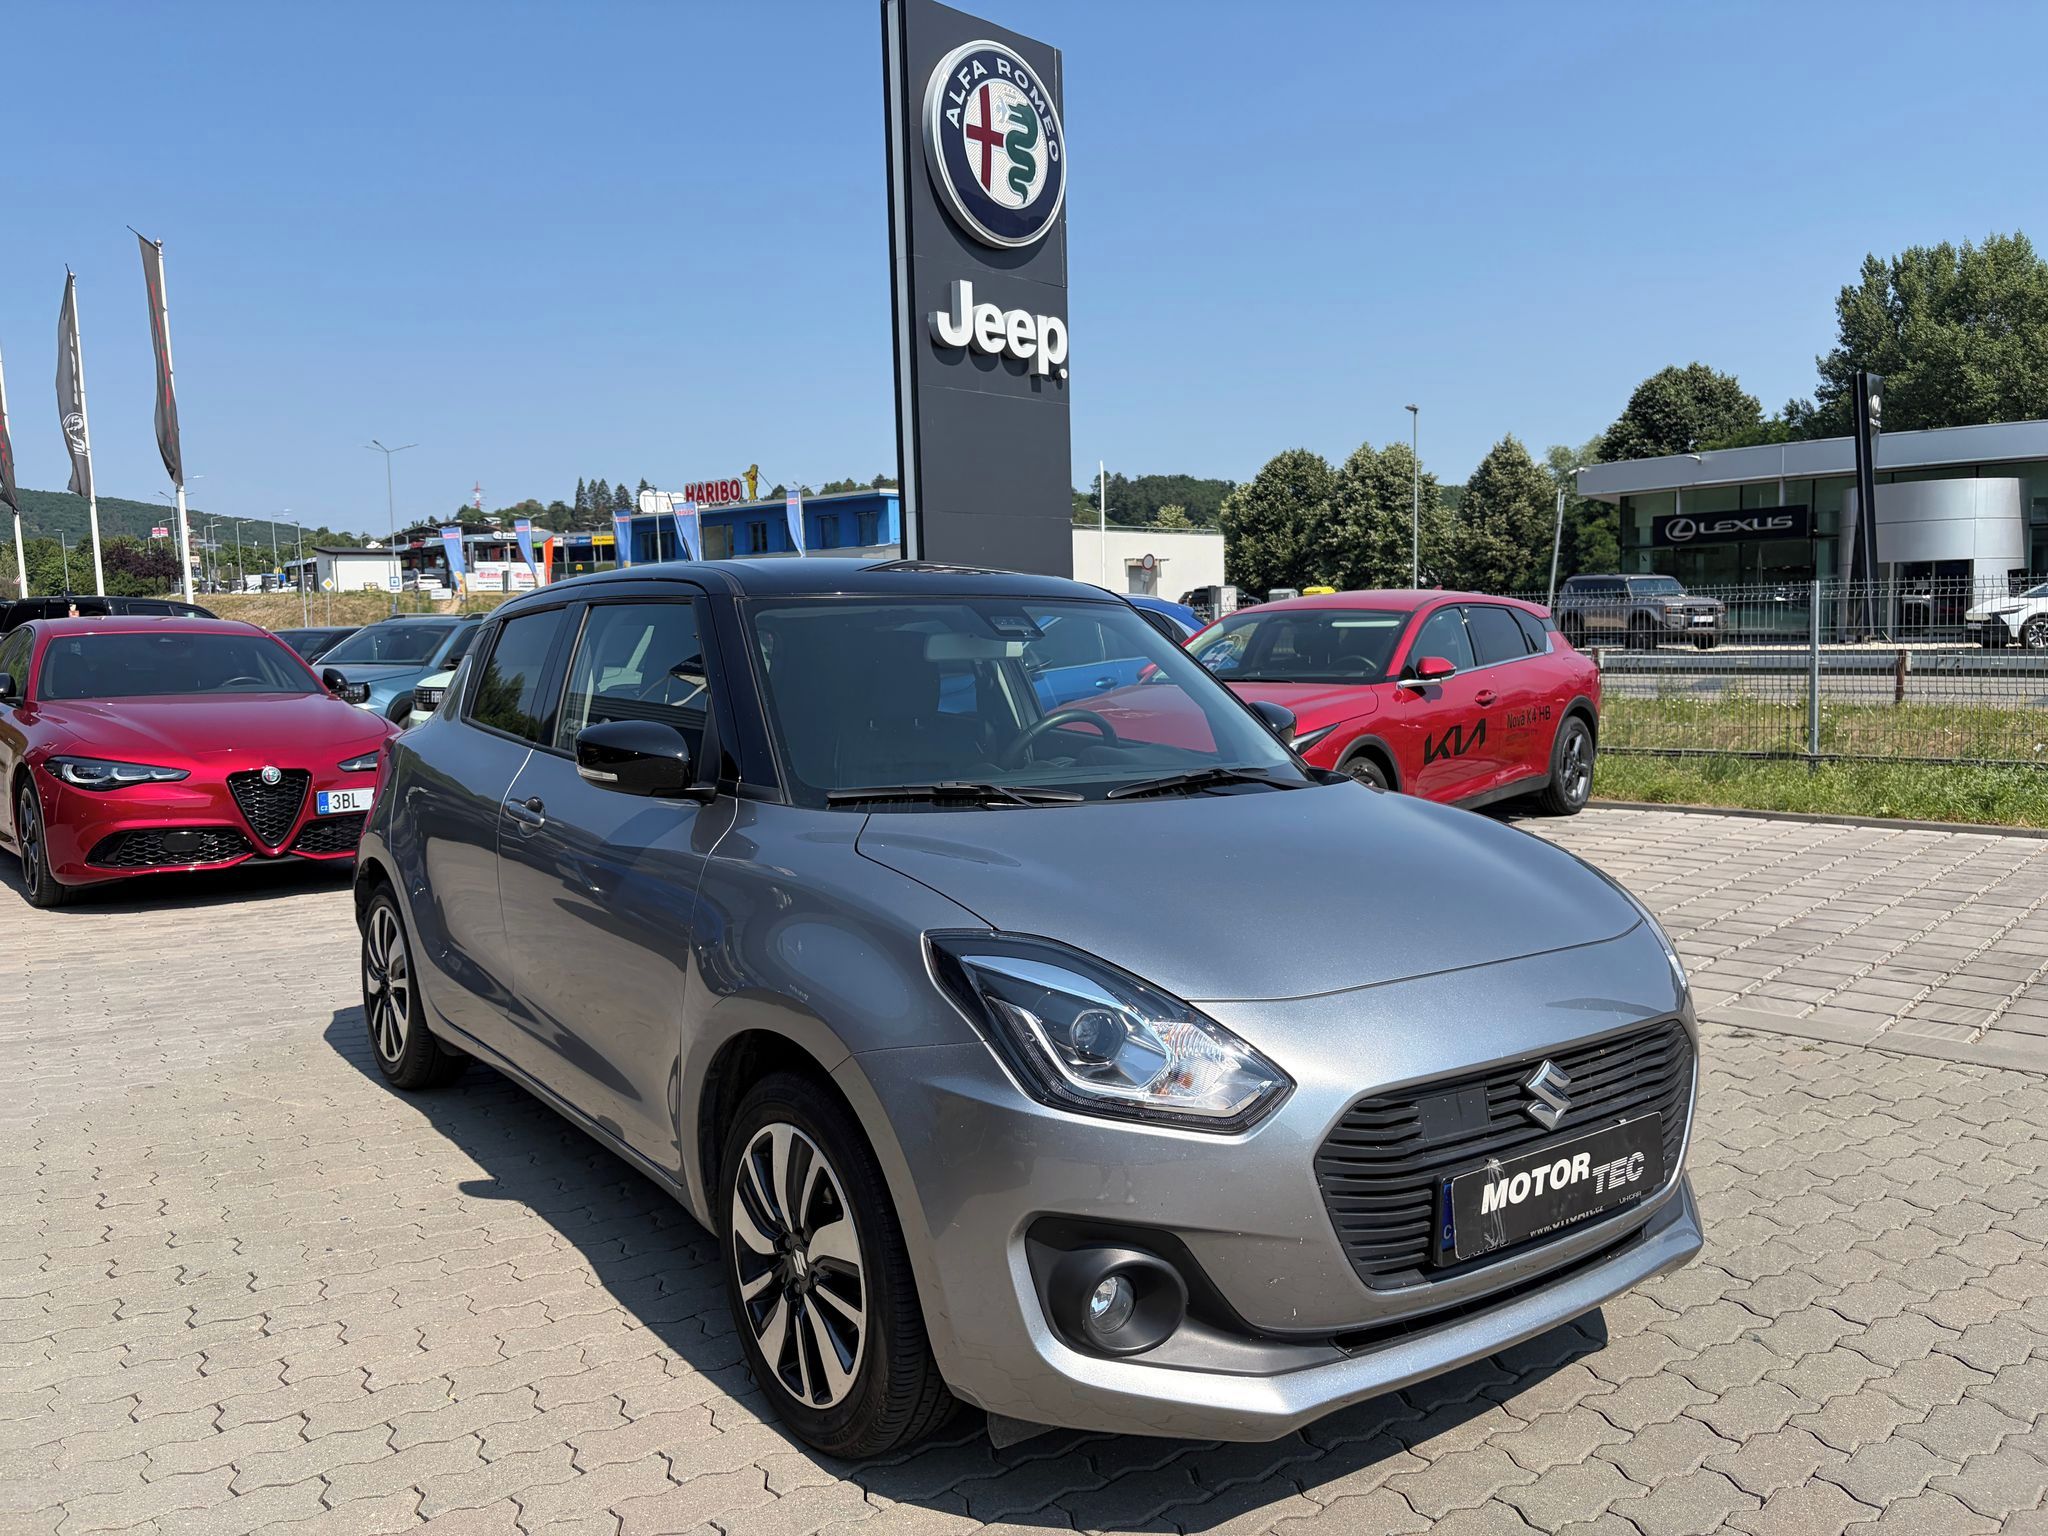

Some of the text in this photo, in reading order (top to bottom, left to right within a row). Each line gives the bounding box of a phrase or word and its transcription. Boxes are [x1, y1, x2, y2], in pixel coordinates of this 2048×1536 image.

[945, 57, 1060, 163] ALFA ROMEO
[928, 279, 1069, 376] Jeep
[685, 479, 741, 503] HARIBO
[1699, 515, 1793, 535] LEXUS
[1507, 705, 1551, 729] Nová K4 HB
[1424, 717, 1487, 765] KIA
